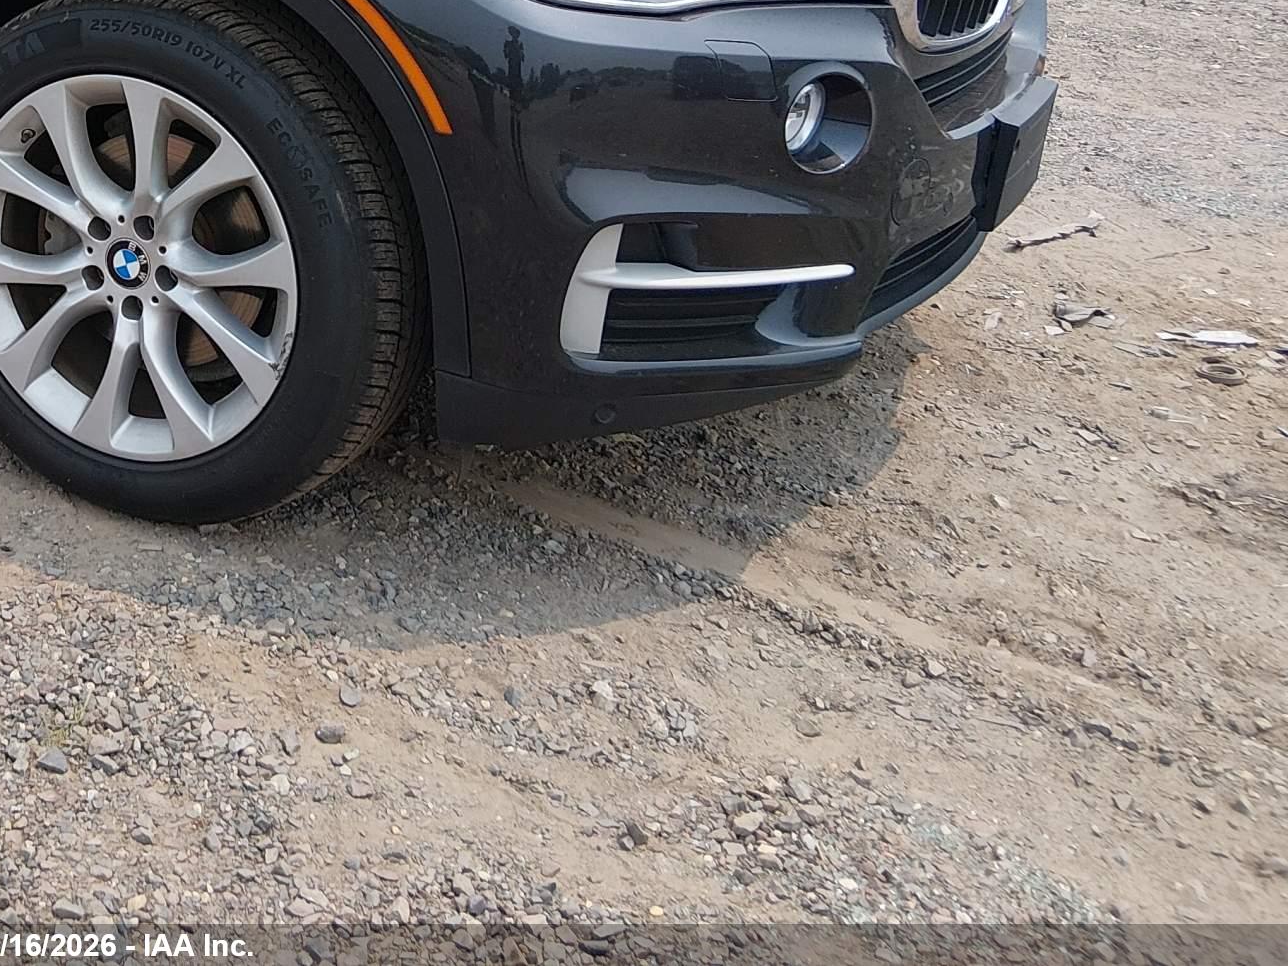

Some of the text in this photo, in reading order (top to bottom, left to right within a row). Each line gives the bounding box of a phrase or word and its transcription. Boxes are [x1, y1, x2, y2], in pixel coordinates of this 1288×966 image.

[89, 18, 247, 89] 255/50R19 107V XL
